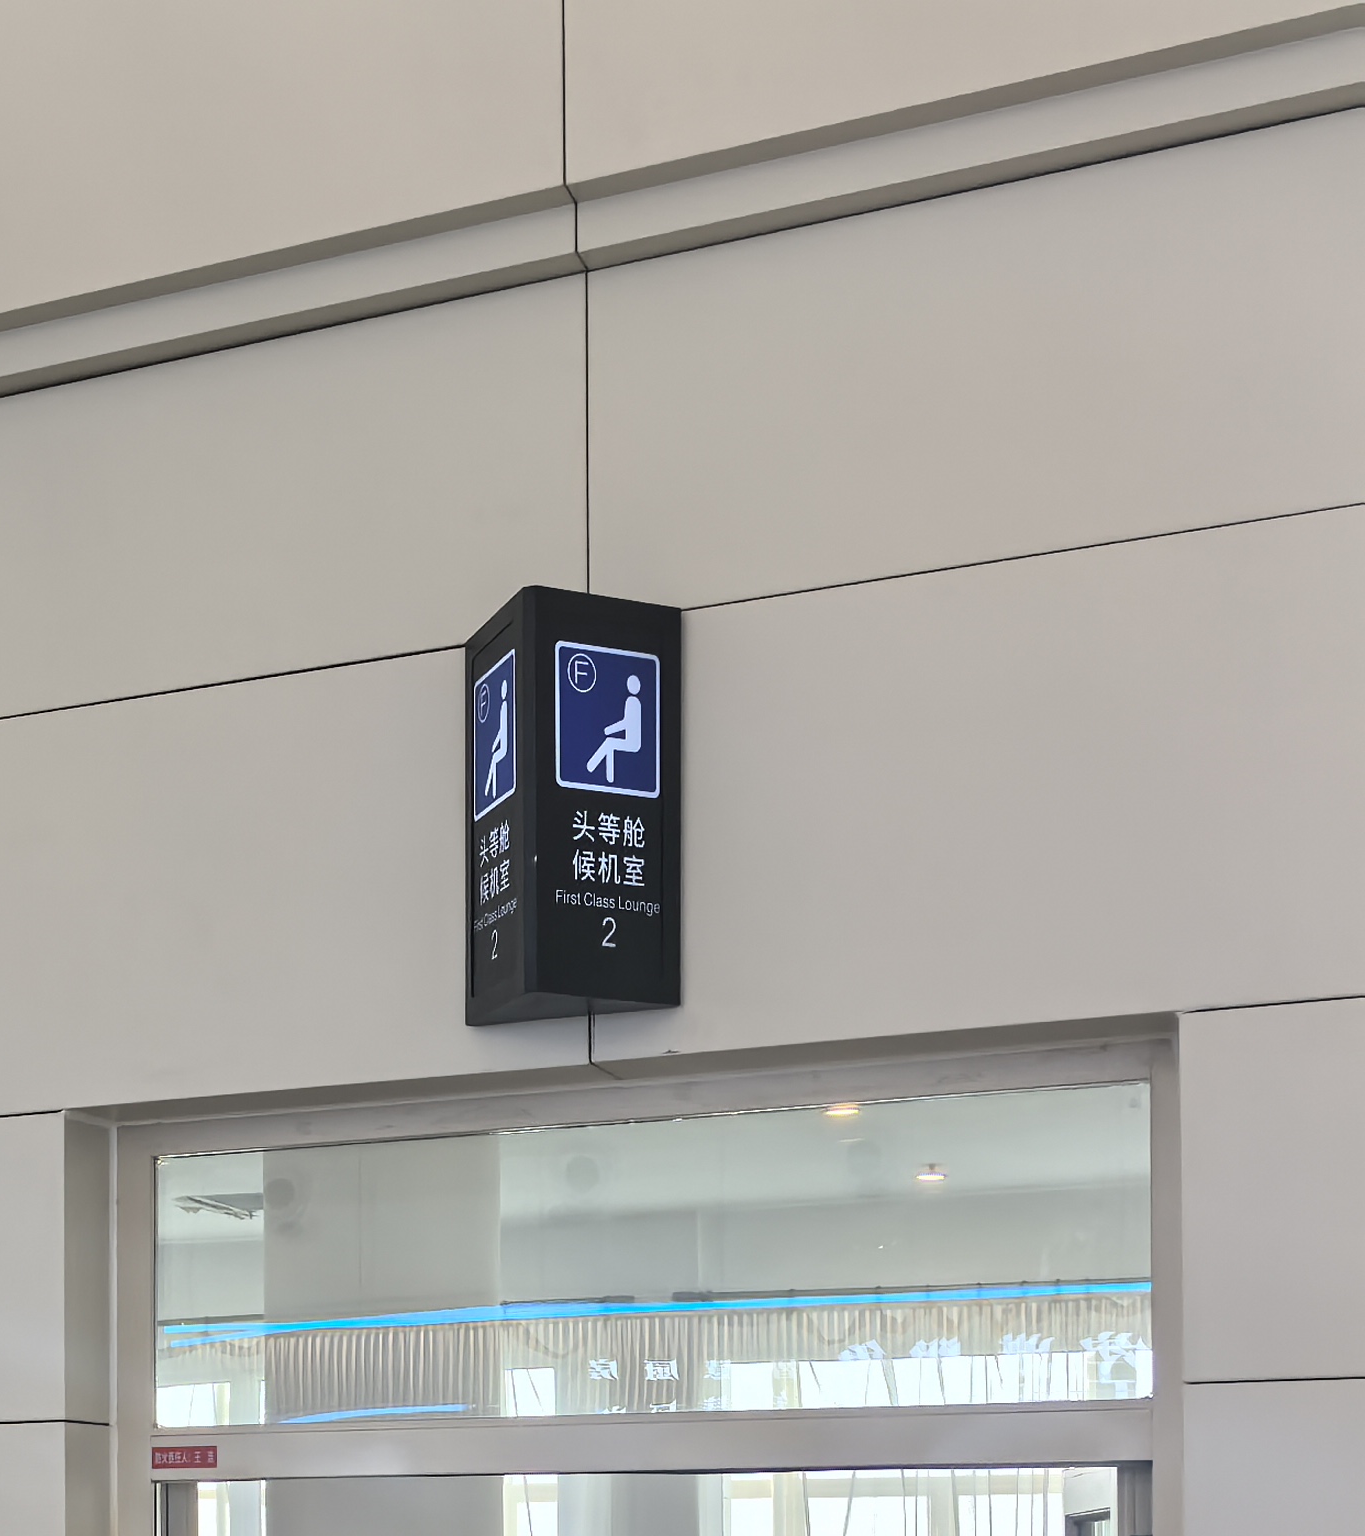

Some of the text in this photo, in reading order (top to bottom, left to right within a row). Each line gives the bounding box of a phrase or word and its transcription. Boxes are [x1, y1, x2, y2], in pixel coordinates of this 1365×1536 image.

[575, 660, 589, 684] F
[479, 819, 510, 868] 头等舱
[572, 809, 645, 848] 头等舱
[480, 859, 510, 906] 候机室
[572, 849, 645, 887] 候机室
[555, 889, 660, 916] First Class Lounge
[491, 929, 498, 960] 2
[601, 916, 616, 947] 2
